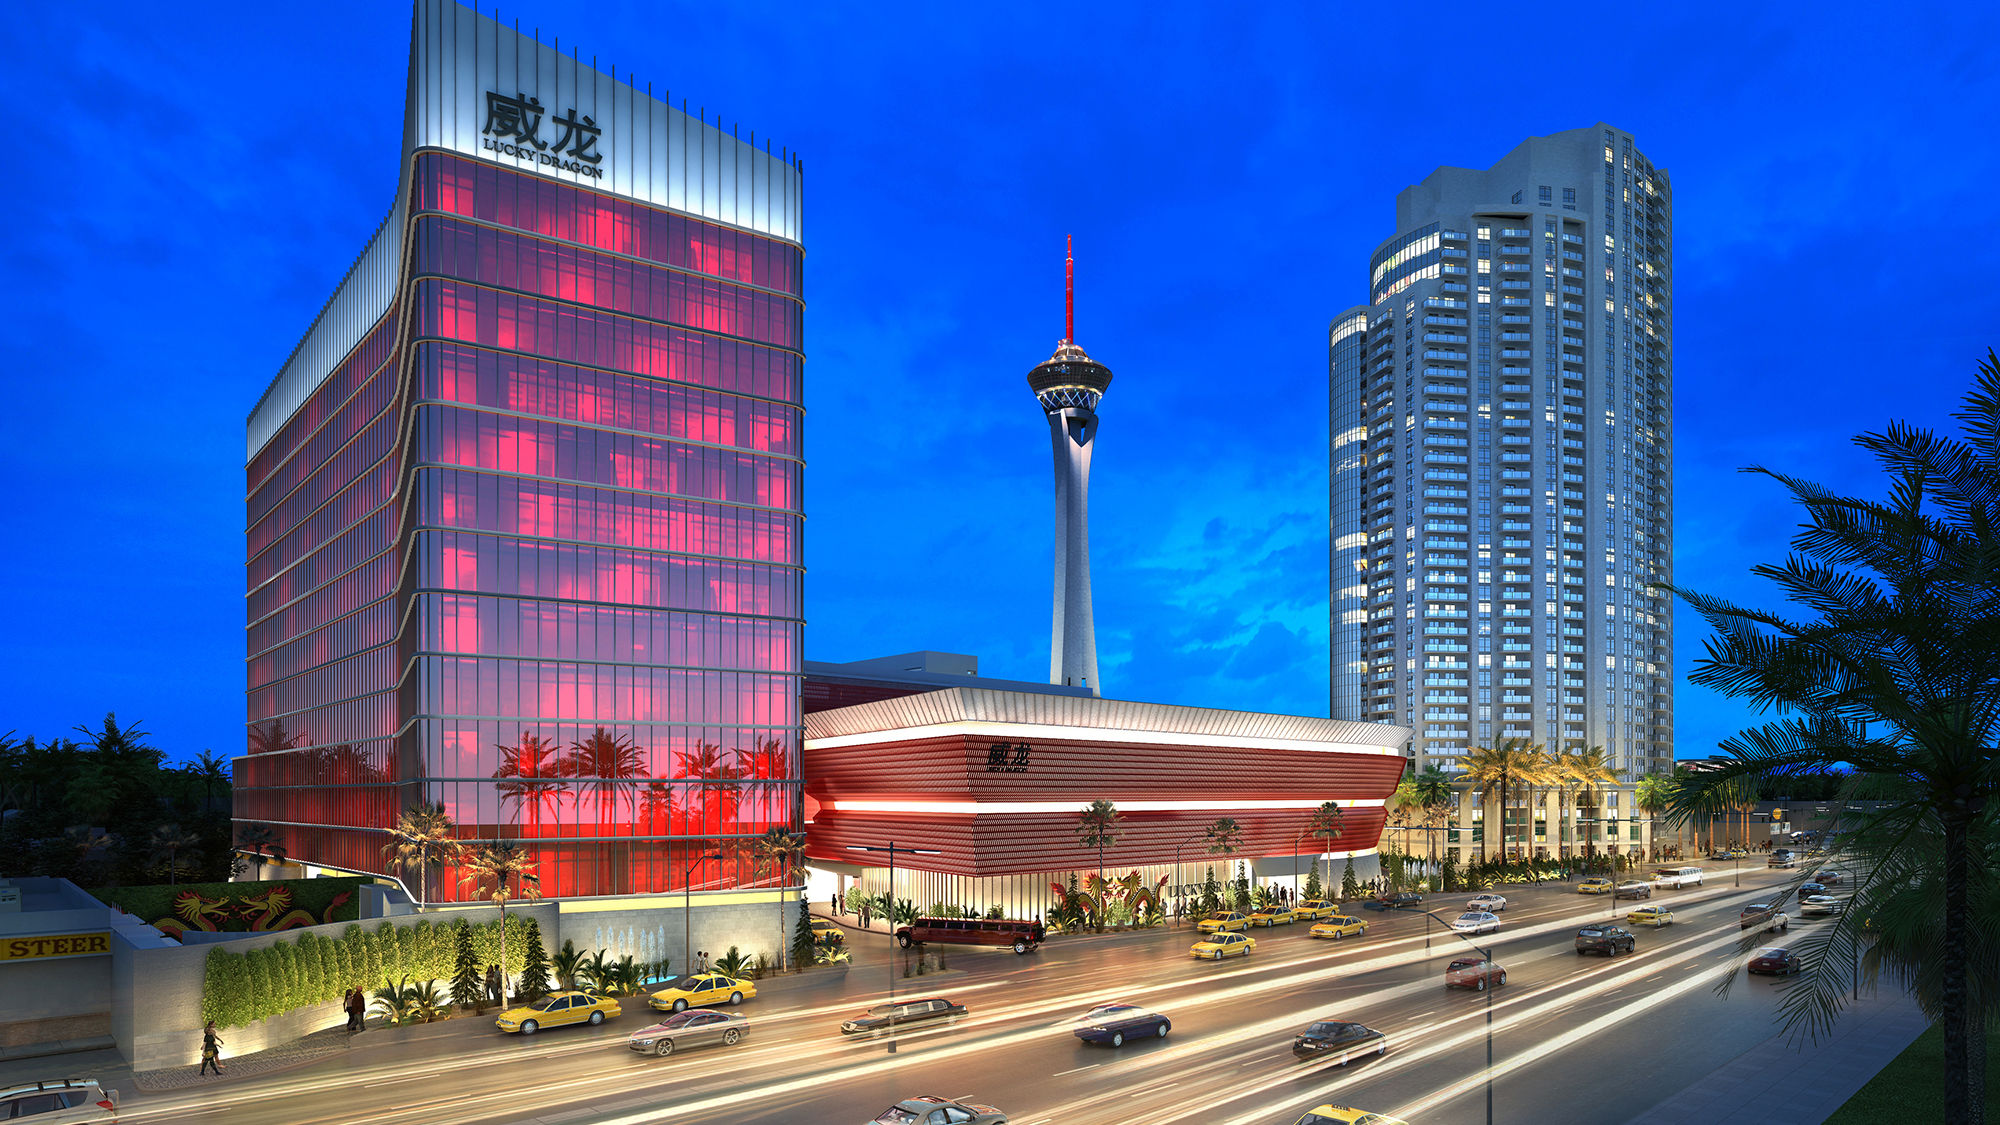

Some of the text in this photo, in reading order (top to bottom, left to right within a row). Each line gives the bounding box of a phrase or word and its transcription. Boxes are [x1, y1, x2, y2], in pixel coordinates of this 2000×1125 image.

[482, 91, 603, 164] 威龙
[484, 138, 603, 179] LUCKY DRAGON
[1168, 882, 1206, 897] LUCKY
[9, 936, 107, 957] STEER
